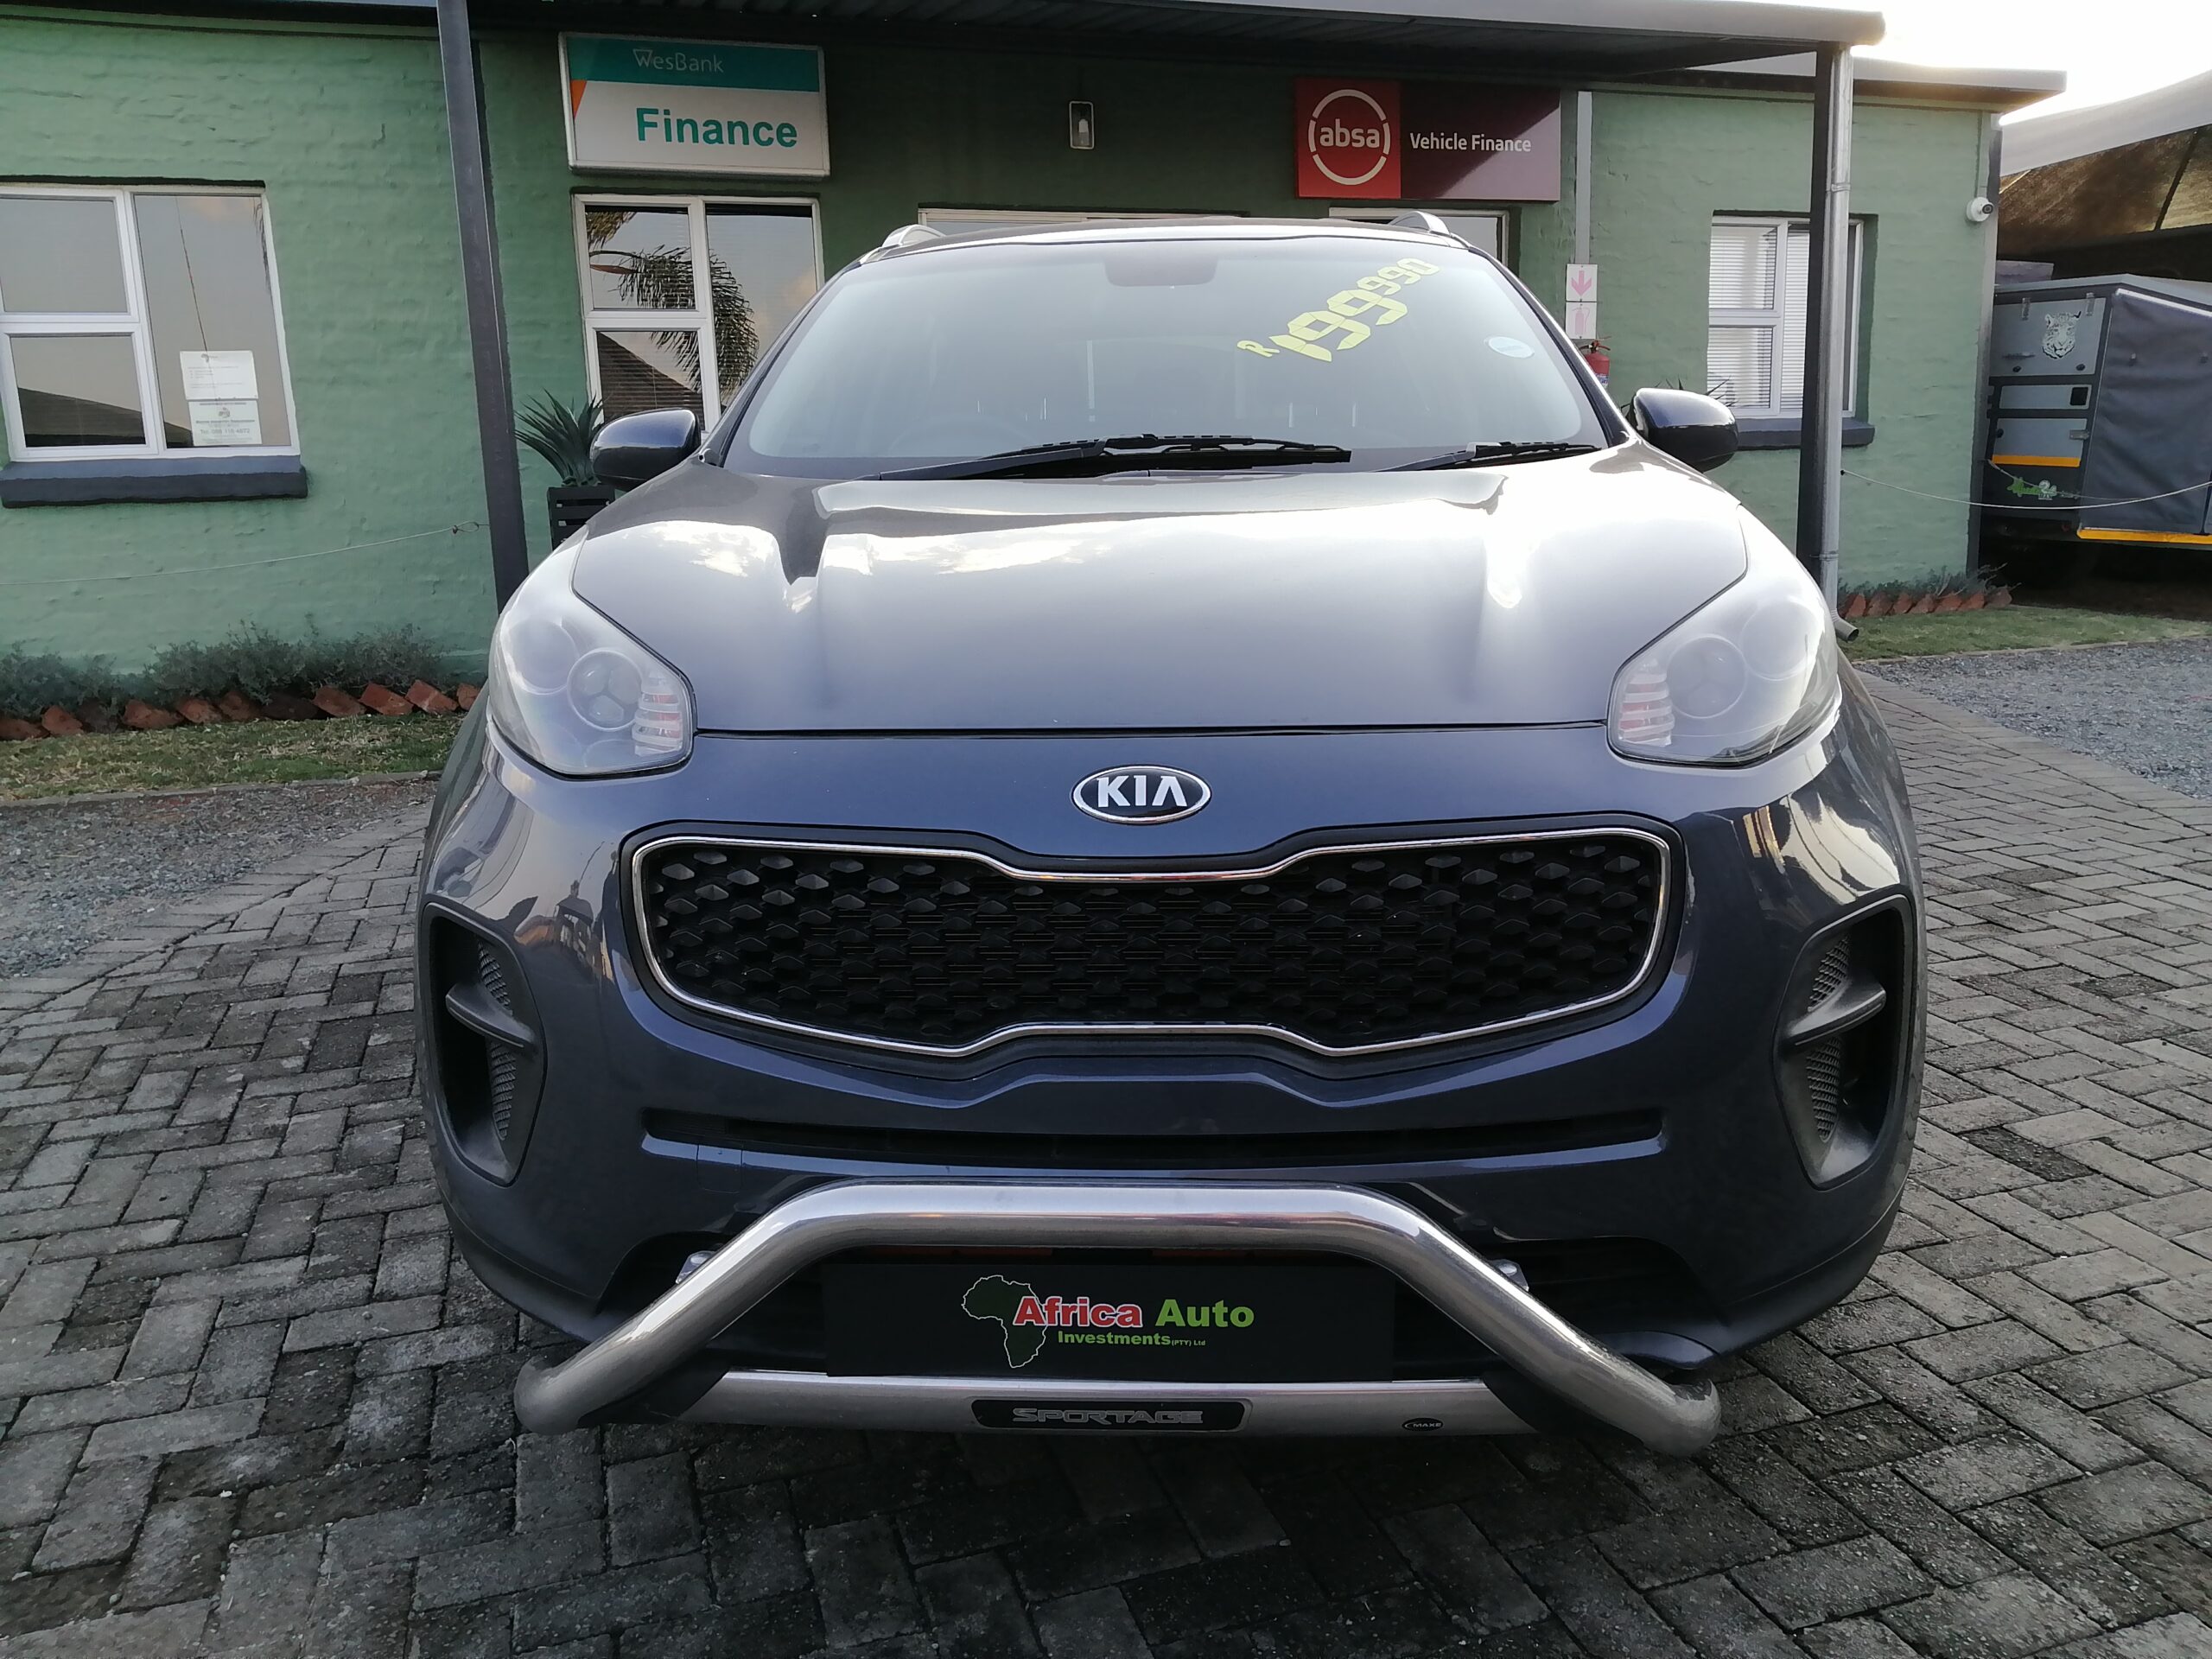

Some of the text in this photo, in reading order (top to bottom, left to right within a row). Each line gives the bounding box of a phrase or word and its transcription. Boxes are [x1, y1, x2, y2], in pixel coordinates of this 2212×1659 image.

[632, 48, 724, 73] WesBank
[636, 107, 798, 148] Finance
[1319, 118, 1381, 149] absa
[1409, 131, 1532, 152] Vehicle Finance
[1096, 775, 1188, 808] KIA
[1012, 1296, 1255, 1328] Africa Auto
[1058, 1331, 1171, 1346] Investments
[1013, 1408, 1205, 1426] SPORTAGE
